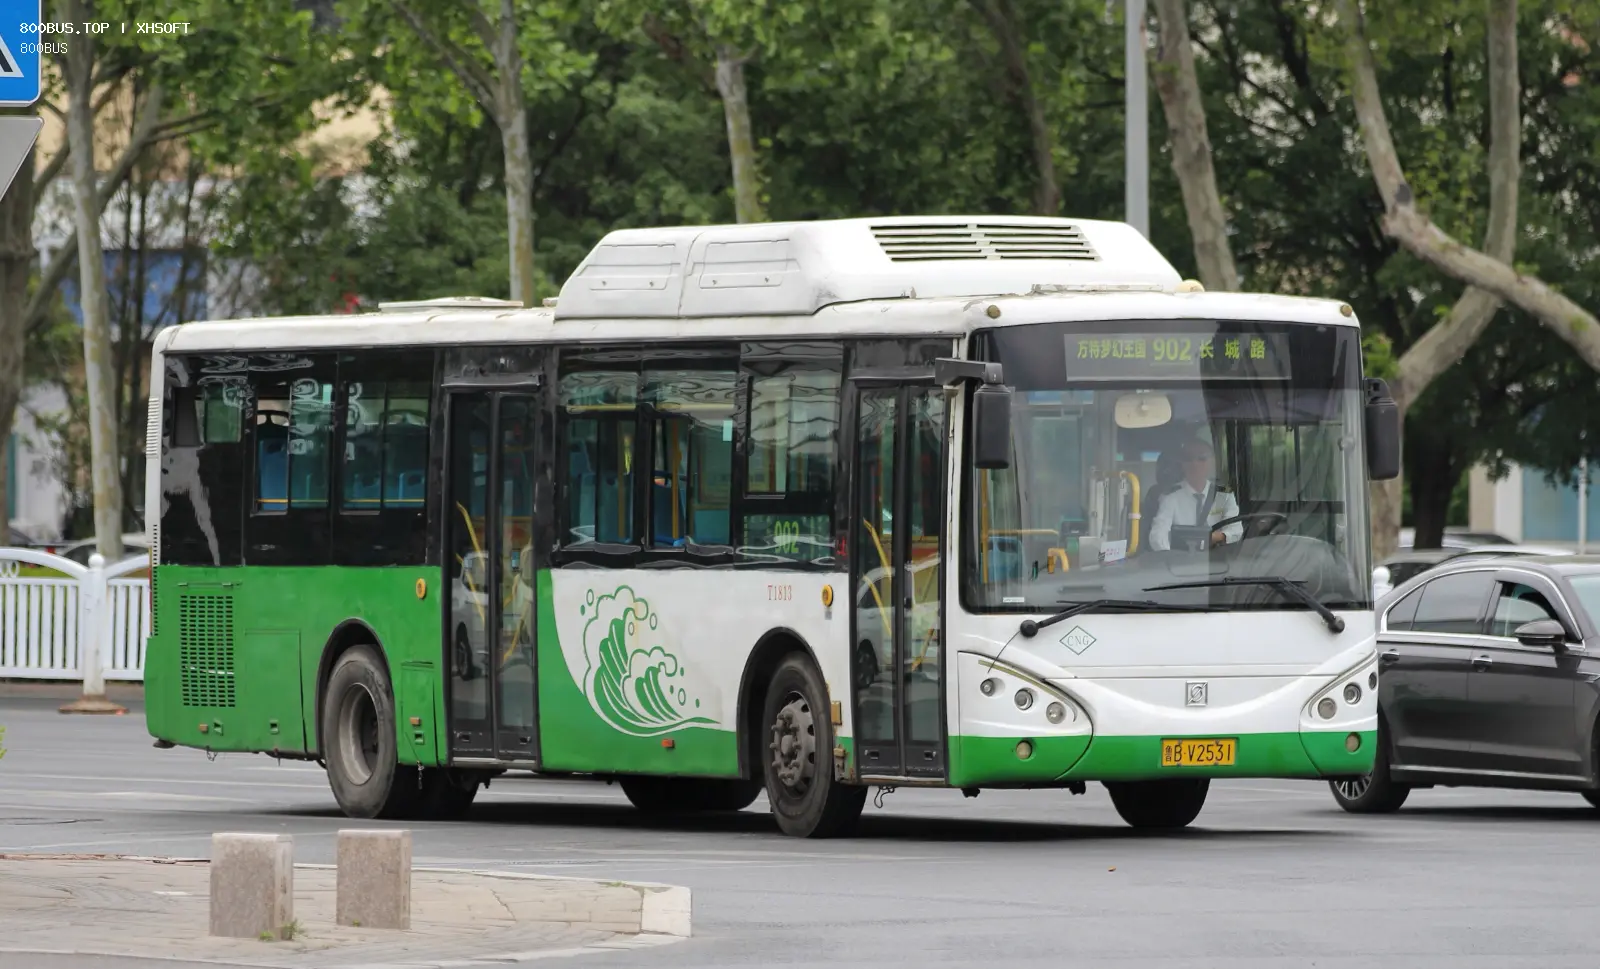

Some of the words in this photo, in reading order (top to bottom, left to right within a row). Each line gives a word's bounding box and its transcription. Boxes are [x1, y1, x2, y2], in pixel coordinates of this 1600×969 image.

[1153, 337, 1192, 361] 902
[1199, 337, 1265, 359] 长城路
[774, 521, 799, 553] 902
[767, 584, 792, 601] T1813
[1067, 635, 1089, 646] CNG
